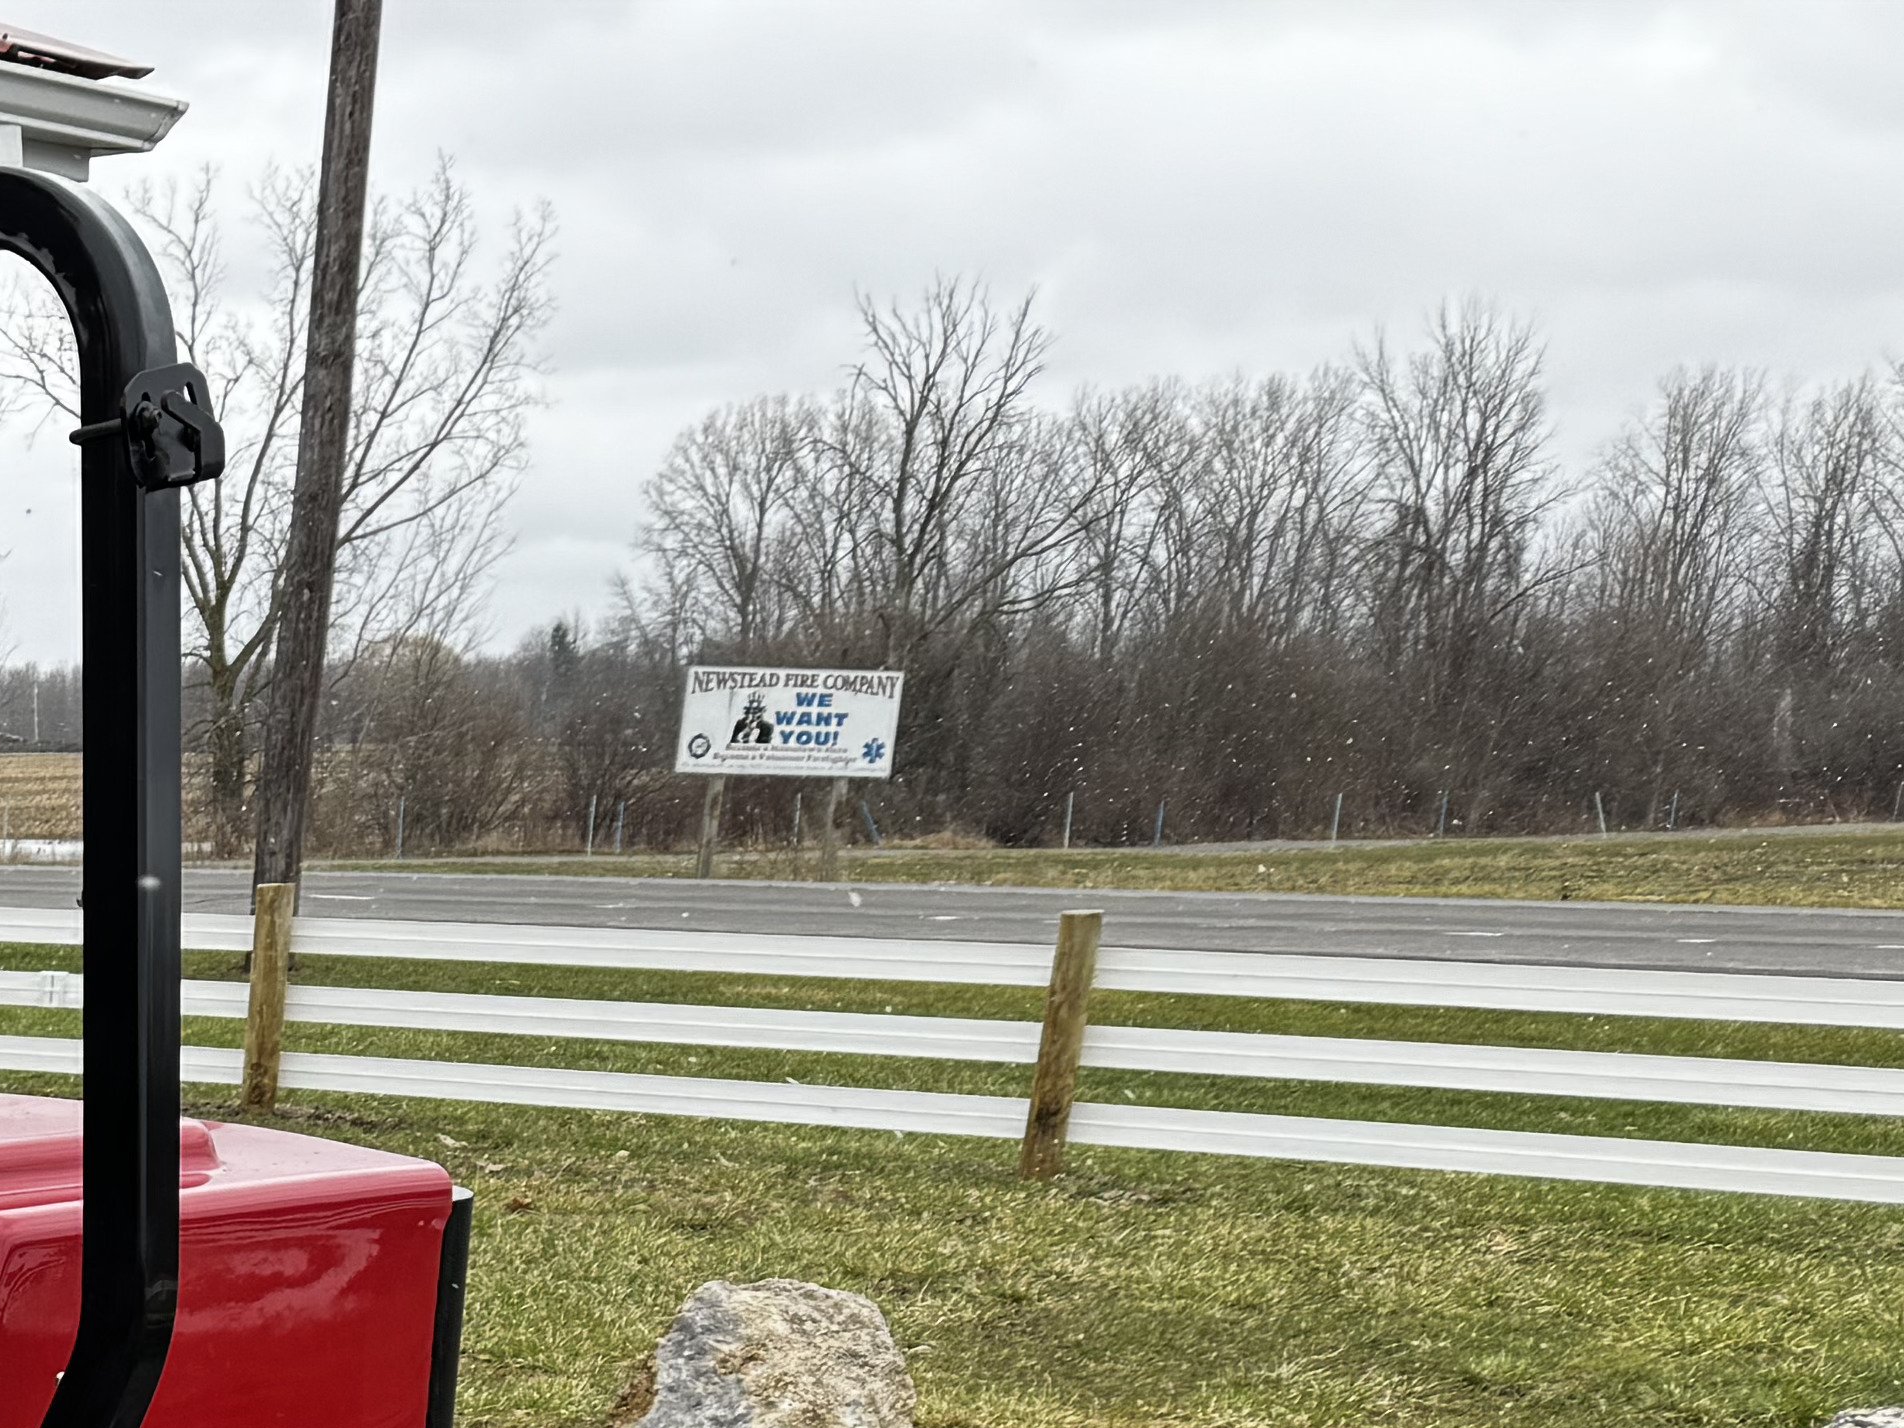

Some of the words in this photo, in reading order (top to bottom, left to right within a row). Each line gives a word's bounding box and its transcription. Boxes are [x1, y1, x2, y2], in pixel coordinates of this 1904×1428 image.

[691, 670, 780, 695] NEWSTEAD
[783, 672, 819, 689] FIRE
[822, 673, 901, 700] COMPANY
[795, 692, 834, 708] WE
[774, 710, 850, 728] WANT
[779, 730, 840, 747] YOU!
